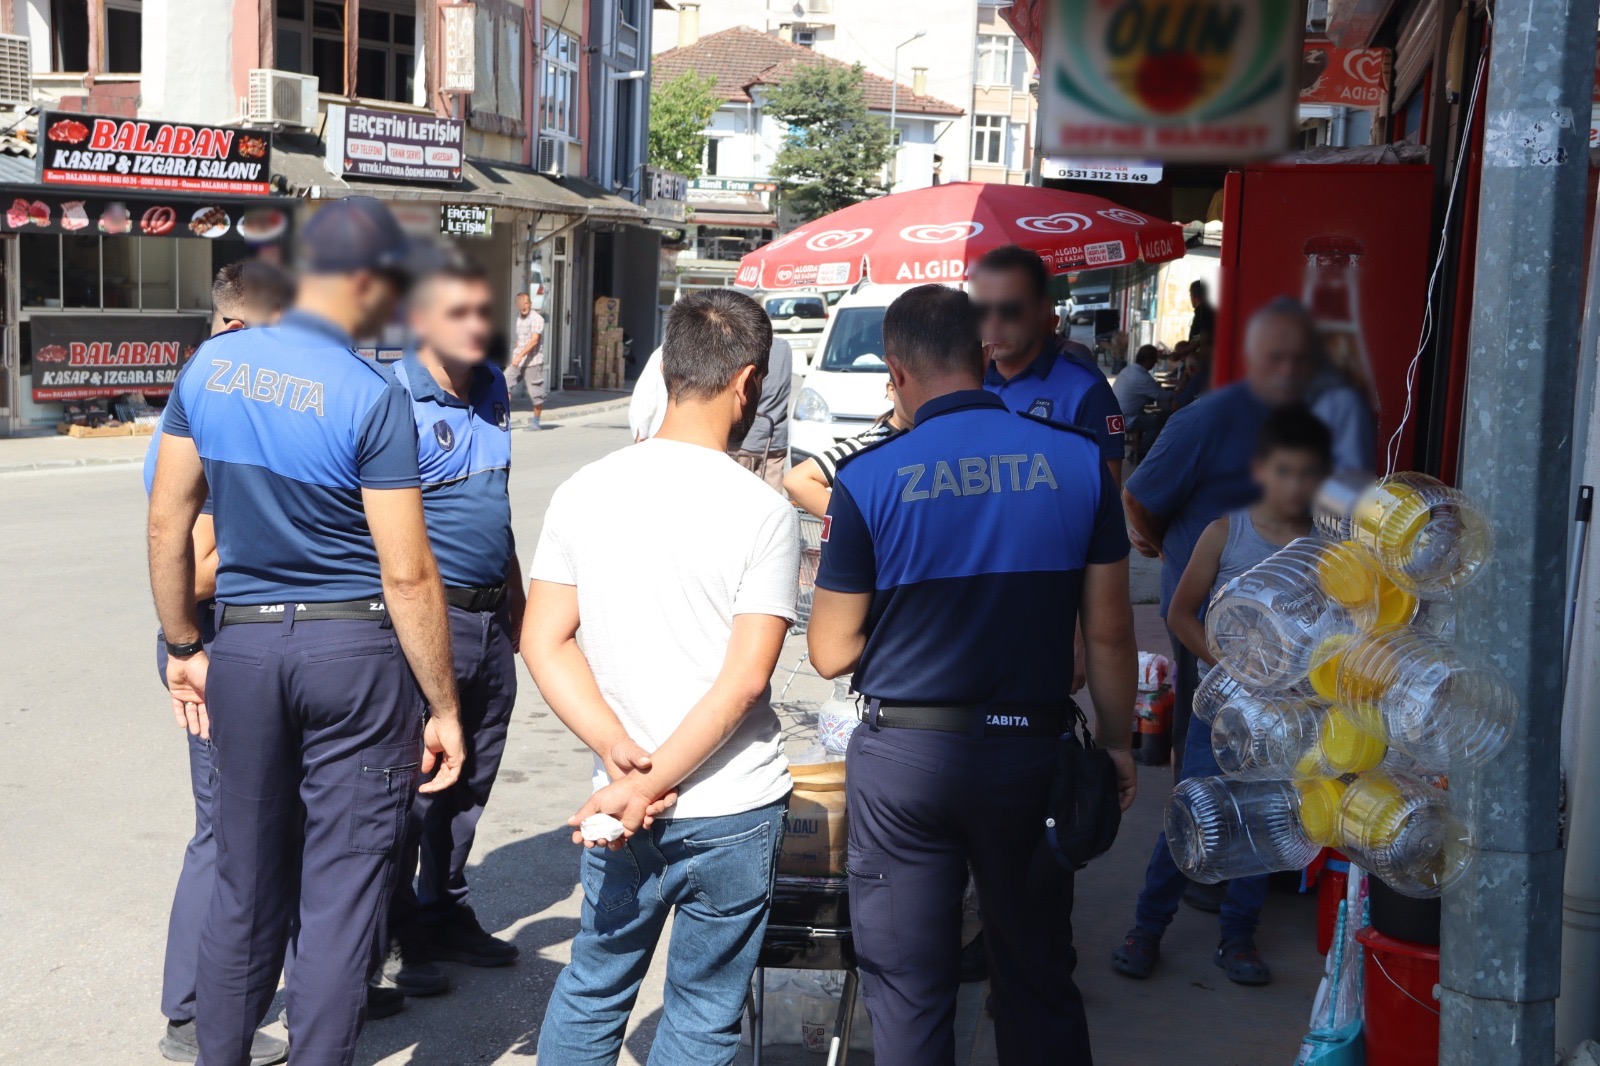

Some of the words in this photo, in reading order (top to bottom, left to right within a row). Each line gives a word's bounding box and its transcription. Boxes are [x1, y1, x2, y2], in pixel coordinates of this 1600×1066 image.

[89, 119, 235, 159] BALABAN
[349, 113, 406, 138] ERÇETİN
[408, 117, 460, 146] İLETİŞİM
[53, 150, 117, 172] KASAP
[116, 157, 131, 174] &
[132, 156, 197, 176] IZGARA
[197, 158, 262, 180] SALONU
[382, 166, 405, 176] FATURA
[405, 166, 425, 177] ÖDEME
[425, 169, 449, 179] NOKTASI
[1058, 169, 1087, 178] 0531
[1090, 171, 1112, 180] 312
[1131, 174, 1148, 182] 49
[698, 180, 722, 189] Simit
[447, 208, 486, 221] ERÇETİN
[447, 219, 486, 234] İLETİŞİM
[68, 341, 180, 367] BALABAN
[42, 371, 91, 386] KASAP
[90, 371, 102, 386] &
[103, 370, 154, 385] IZGARA
[205, 358, 324, 416] ZABITA
[898, 453, 1058, 502] ZABITA
